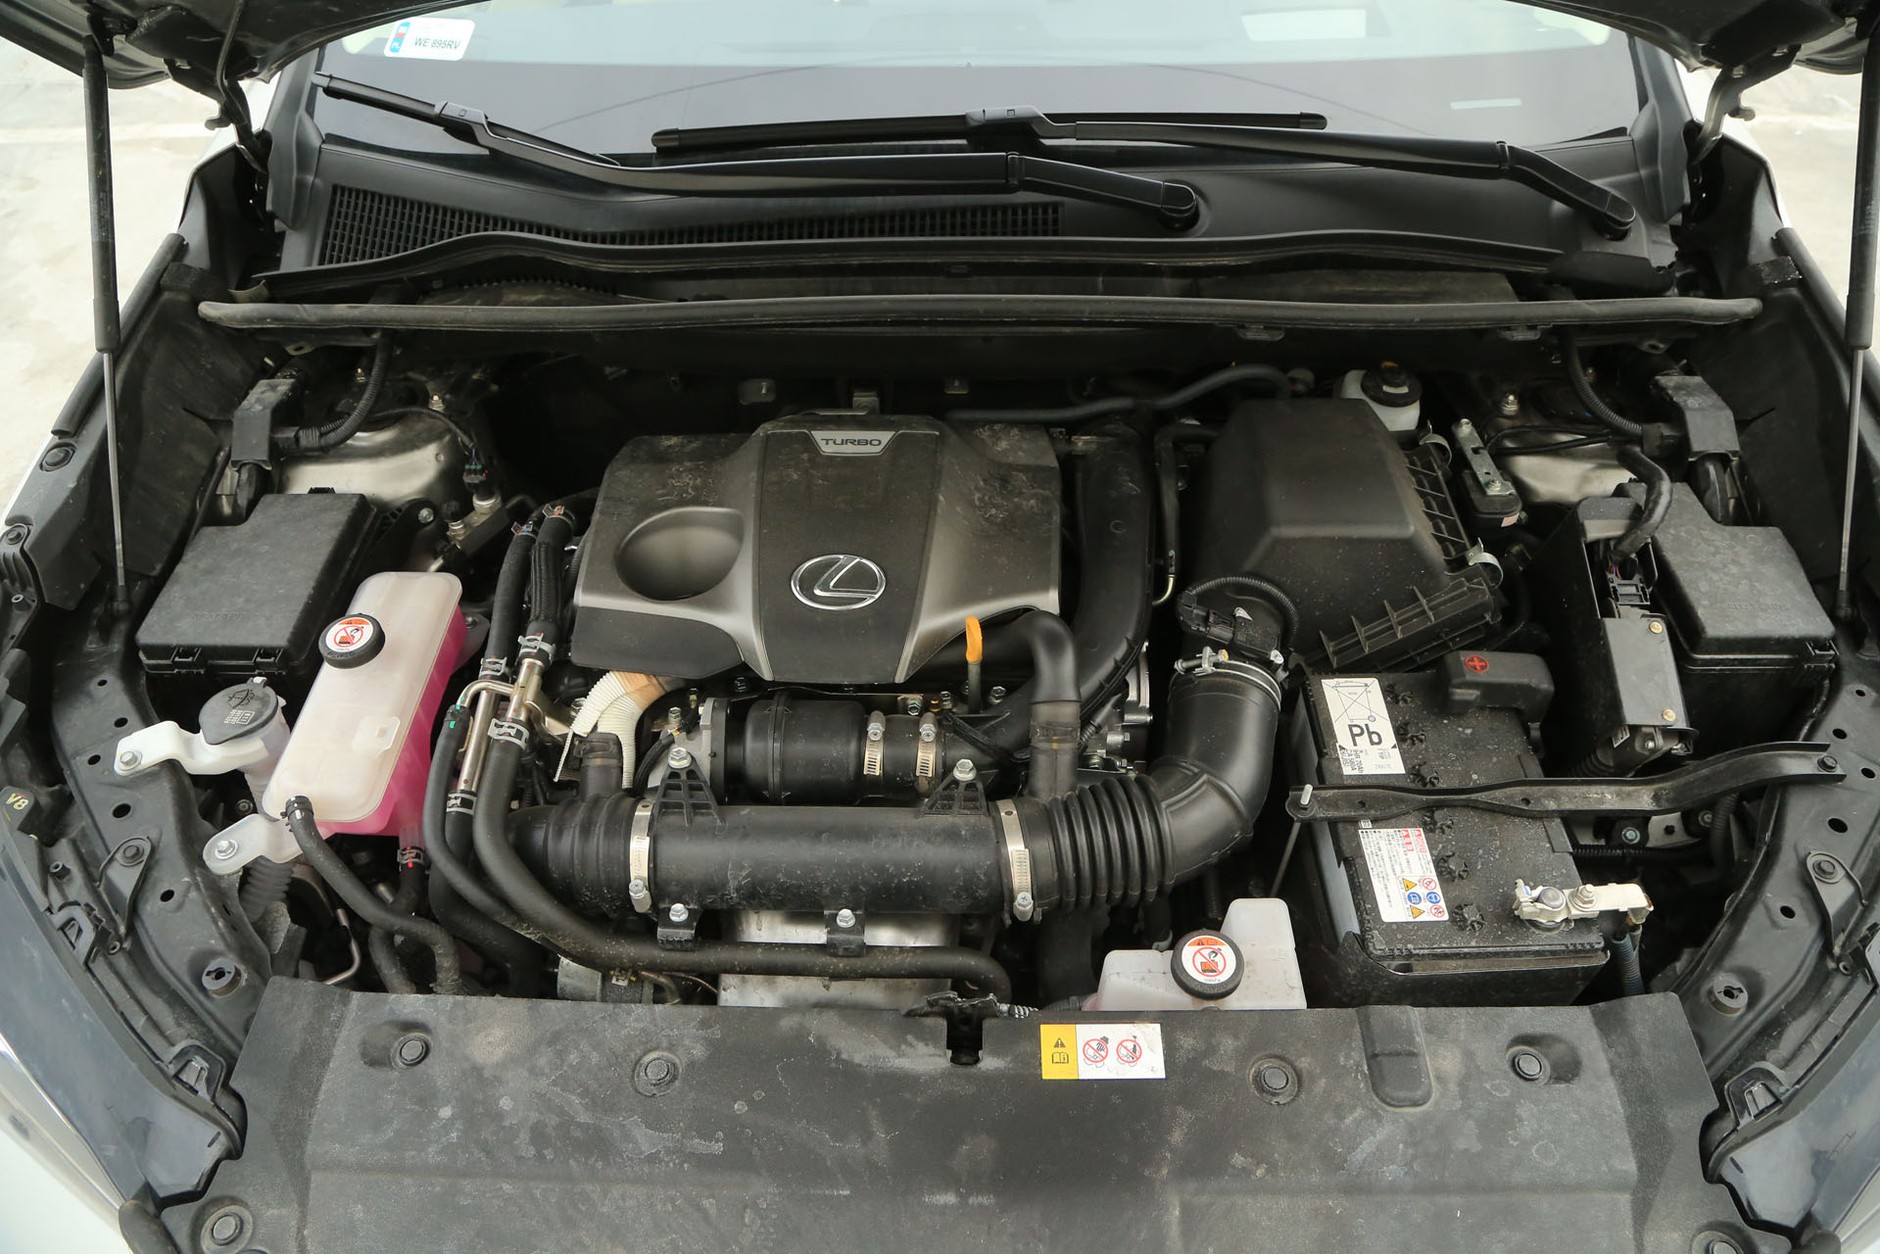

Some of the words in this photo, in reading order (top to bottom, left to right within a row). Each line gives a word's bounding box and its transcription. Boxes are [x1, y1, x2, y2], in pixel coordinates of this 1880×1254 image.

[413, 37, 430, 47] WE
[431, 38, 462, 50] 895RV
[820, 438, 882, 447] TURBO
[1347, 723, 1383, 748] Pb
[6, 792, 29, 810] V8
